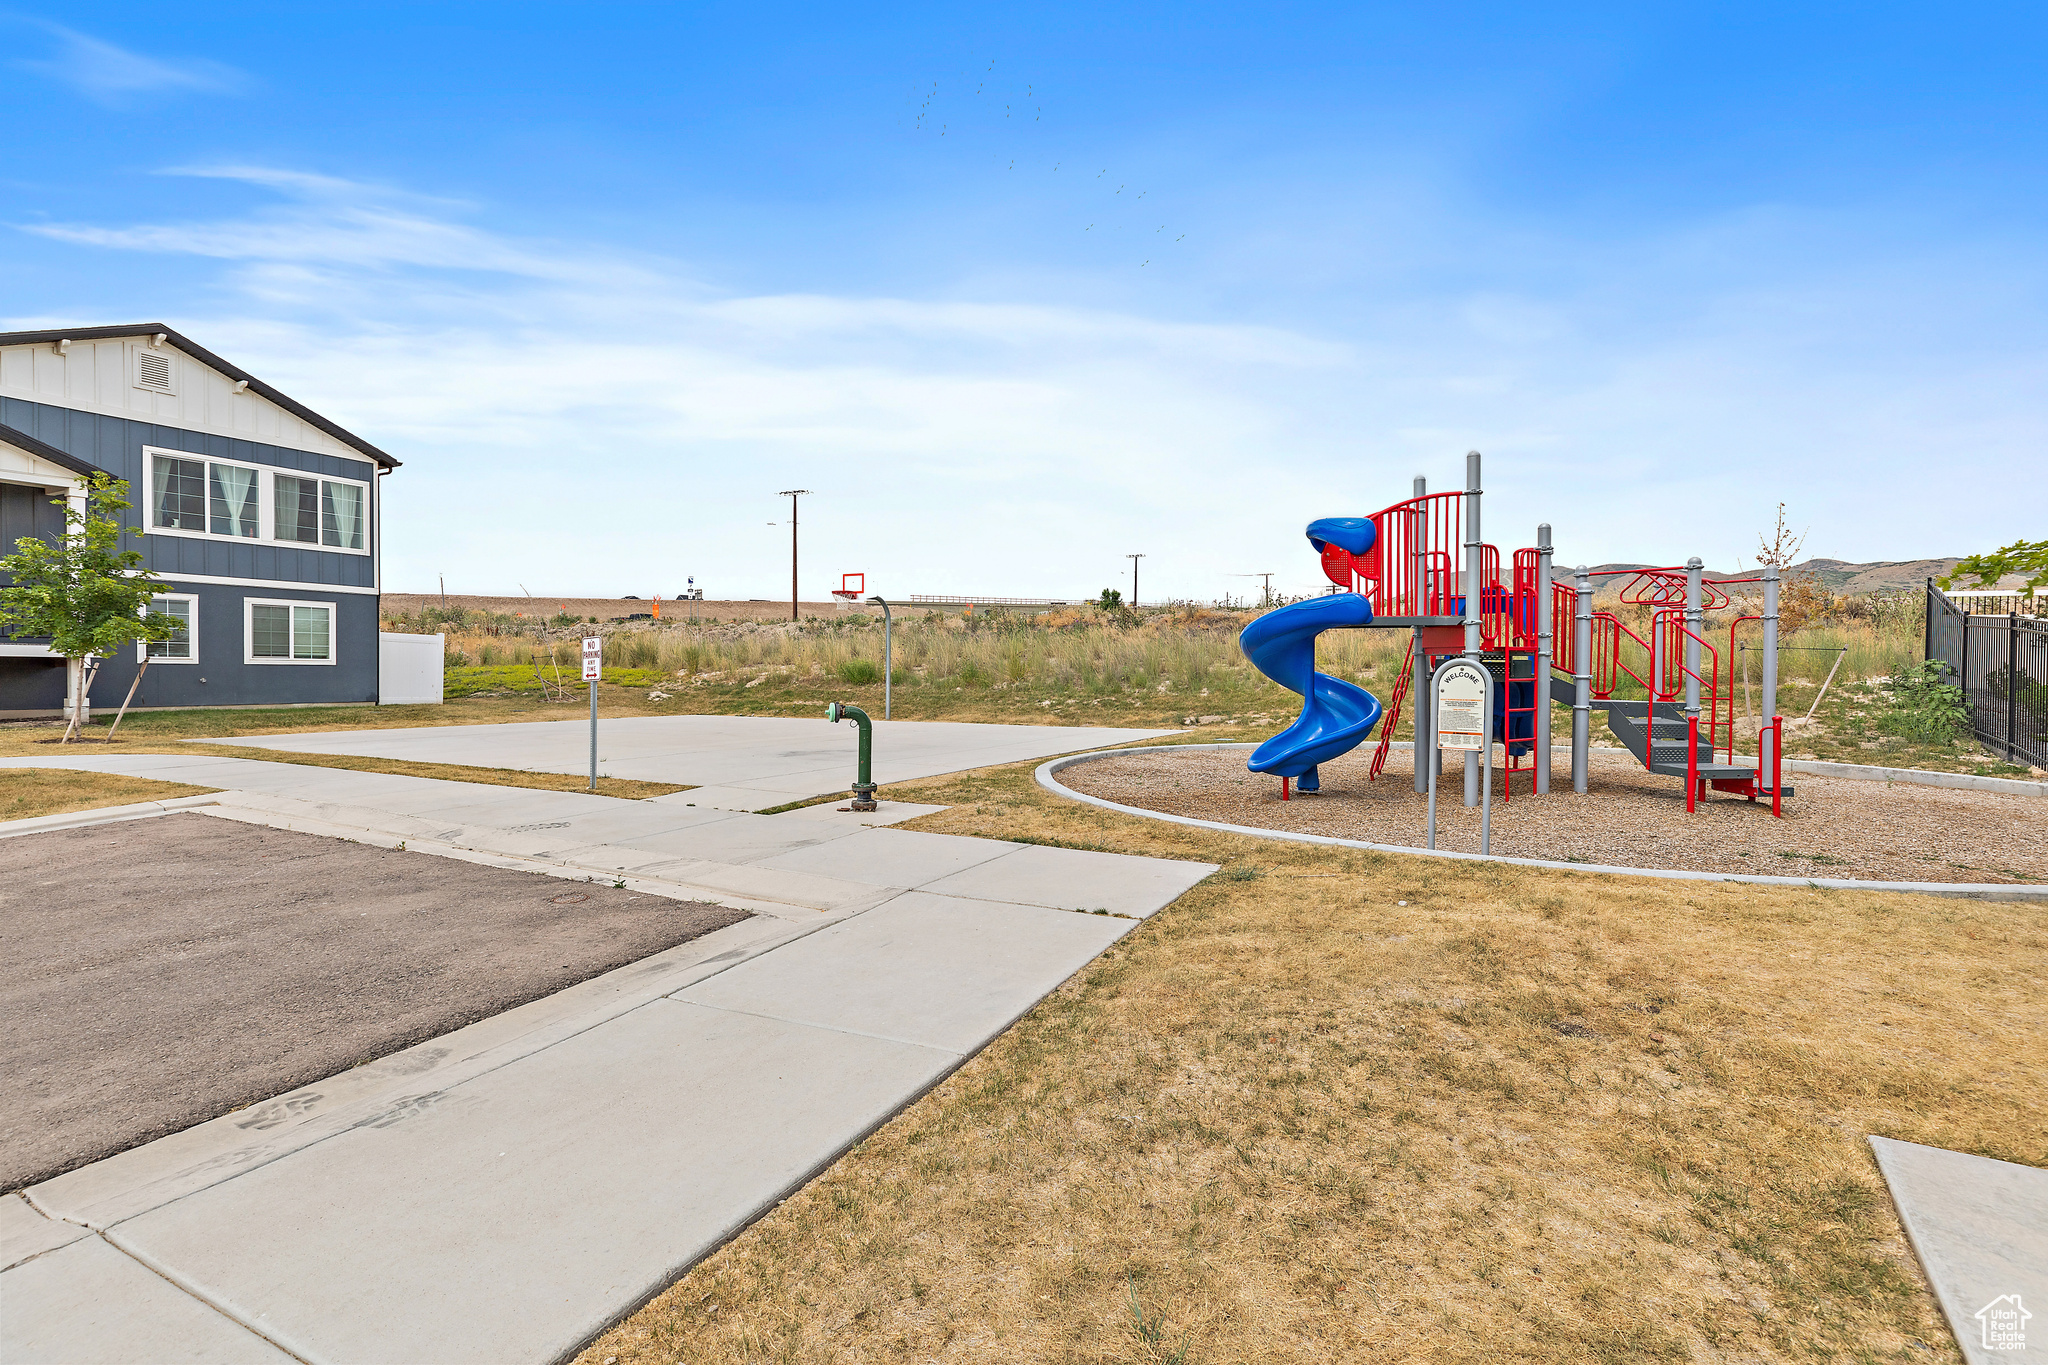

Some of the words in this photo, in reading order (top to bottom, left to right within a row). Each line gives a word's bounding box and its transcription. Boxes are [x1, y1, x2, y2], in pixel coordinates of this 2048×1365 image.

[587, 641, 596, 650] NO
[583, 650, 600, 660] PARKING
[1444, 671, 1480, 685] WELCOME
